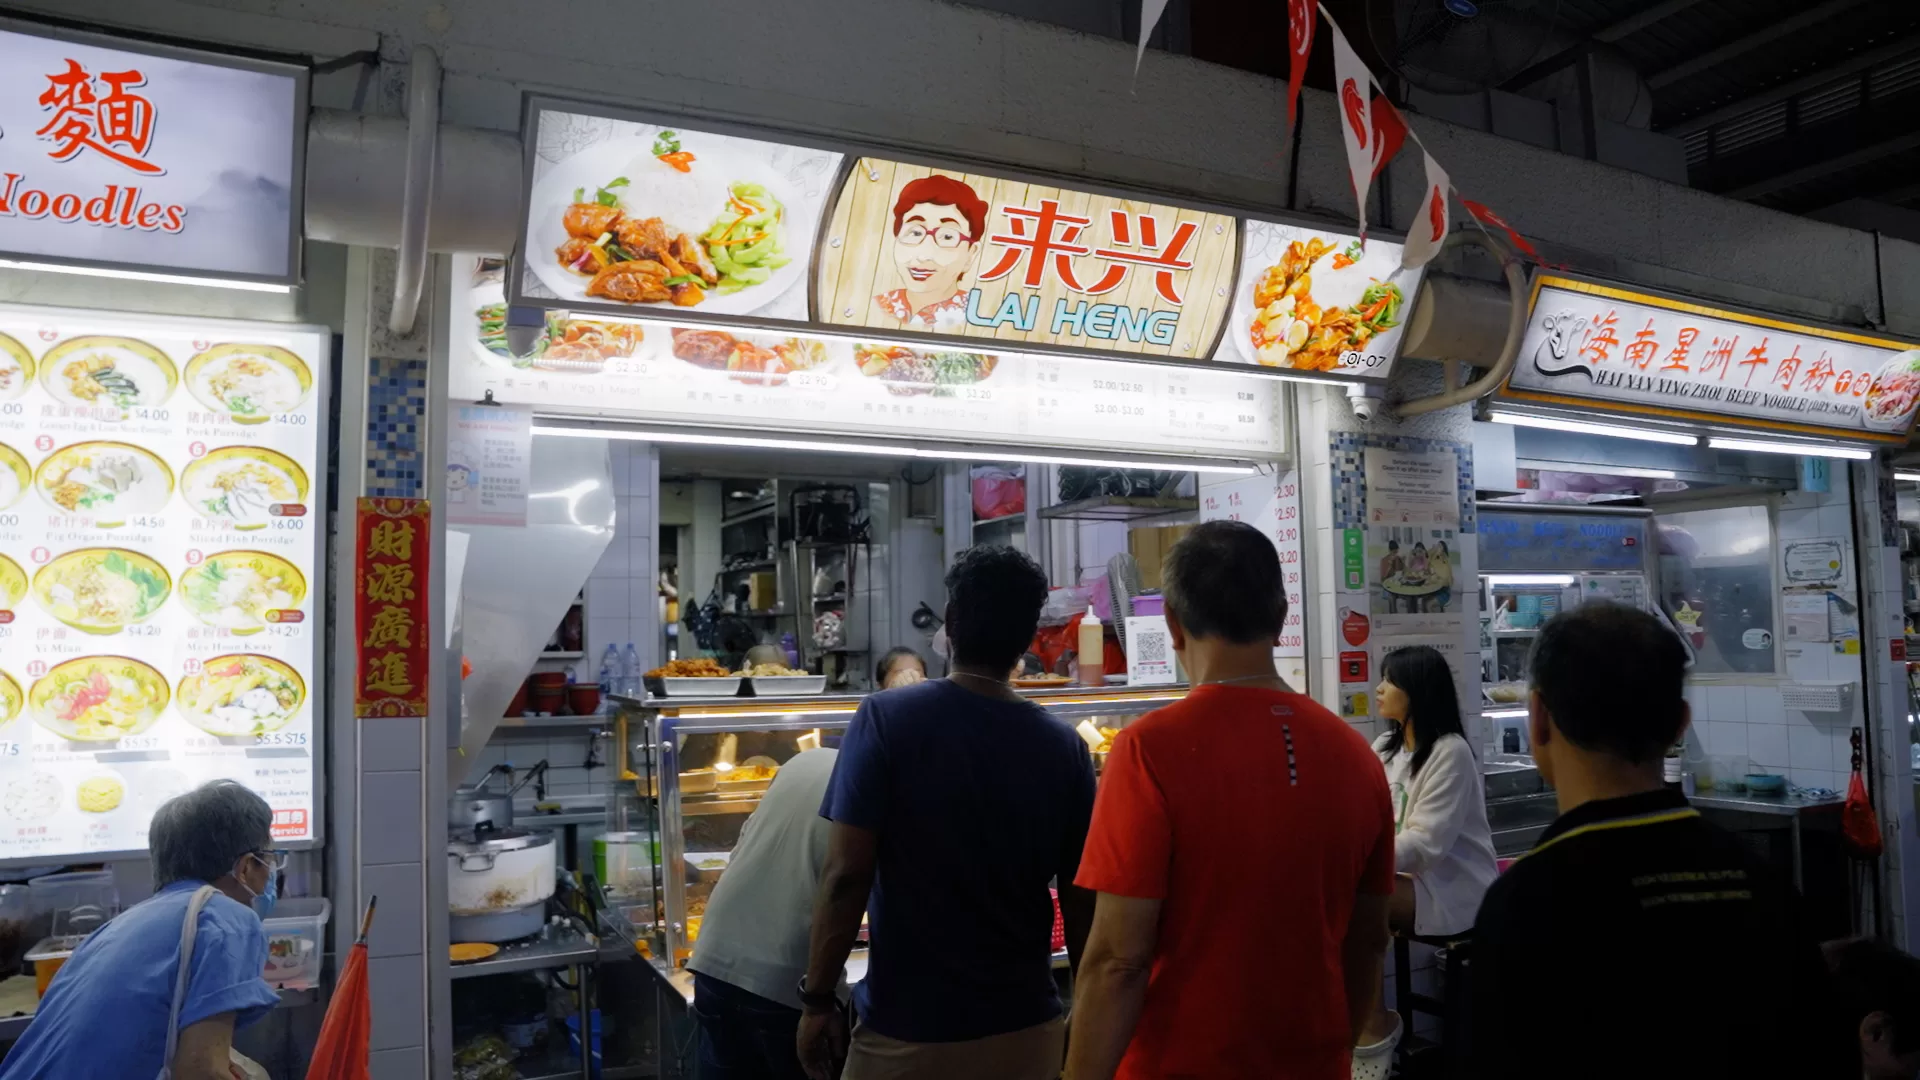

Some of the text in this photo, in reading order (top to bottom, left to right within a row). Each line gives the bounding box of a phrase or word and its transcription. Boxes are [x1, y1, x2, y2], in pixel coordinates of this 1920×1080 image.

[36, 58, 167, 176] 麵
[977, 198, 1200, 305] 来兴
[966, 288, 1180, 347] LAI HENG
[1577, 310, 1837, 395] 海南星洲牛肉粉
[1346, 352, 1387, 368] 01-07
[615, 362, 647, 373] $2.30
[799, 375, 827, 386] $2.90
[1595, 369, 1622, 387] HAI
[1626, 373, 1653, 392] NAN
[1657, 377, 1690, 397] XING
[1689, 383, 1727, 401] ZHOU
[1726, 389, 1761, 406] BEEF
[1762, 393, 1809, 412] NOODLE
[135, 409, 170, 421] $4.00
[273, 413, 307, 425] $4.00
[186, 427, 258, 439] Pork Porridge
[1274, 484, 1295, 499] $2.30
[1275, 506, 1296, 521] $2.50
[132, 516, 165, 528] $4.50
[271, 518, 304, 531] $6.00
[46, 531, 153, 543] Pig Organ Porridge
[189, 534, 295, 545] Sliced Fish Porridge
[1276, 528, 1297, 543] $2.90
[363, 520, 418, 696] 財源廣進
[128, 625, 162, 637] $4.20
[268, 625, 300, 637] $4.20
[35, 643, 82, 654] Yi Mian
[244, 642, 273, 652] Kway
